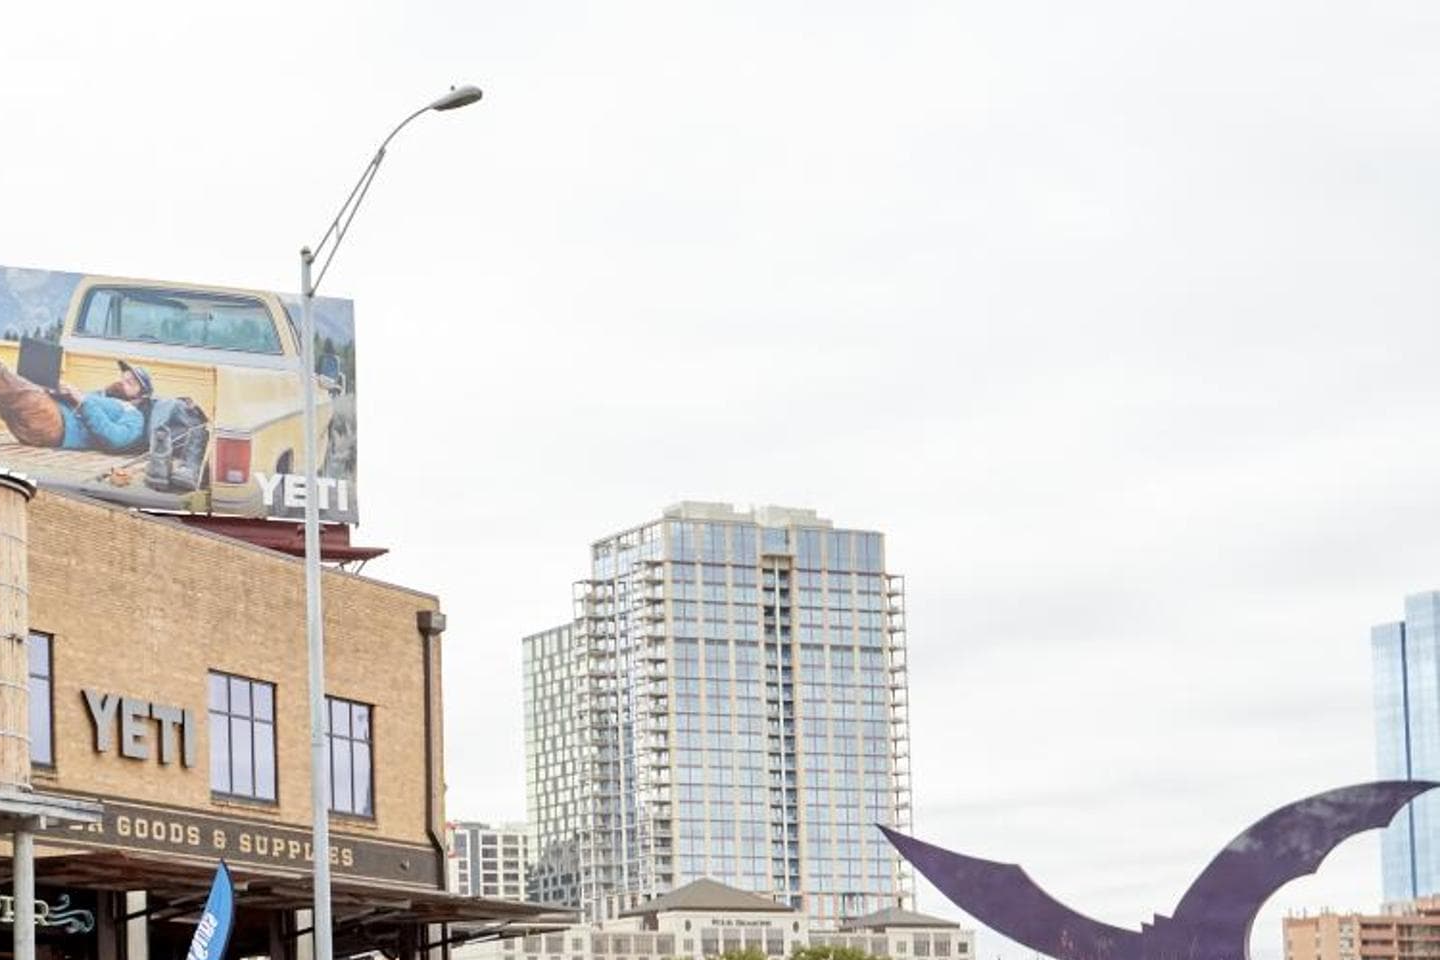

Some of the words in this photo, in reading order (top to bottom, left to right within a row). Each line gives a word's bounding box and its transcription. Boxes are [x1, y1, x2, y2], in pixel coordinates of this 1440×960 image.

[253, 472, 348, 511] YETI
[80, 687, 196, 769] YETI
[116, 815, 201, 847] GOODS
[213, 831, 228, 850] &
[239, 833, 355, 867] SUPPLES
